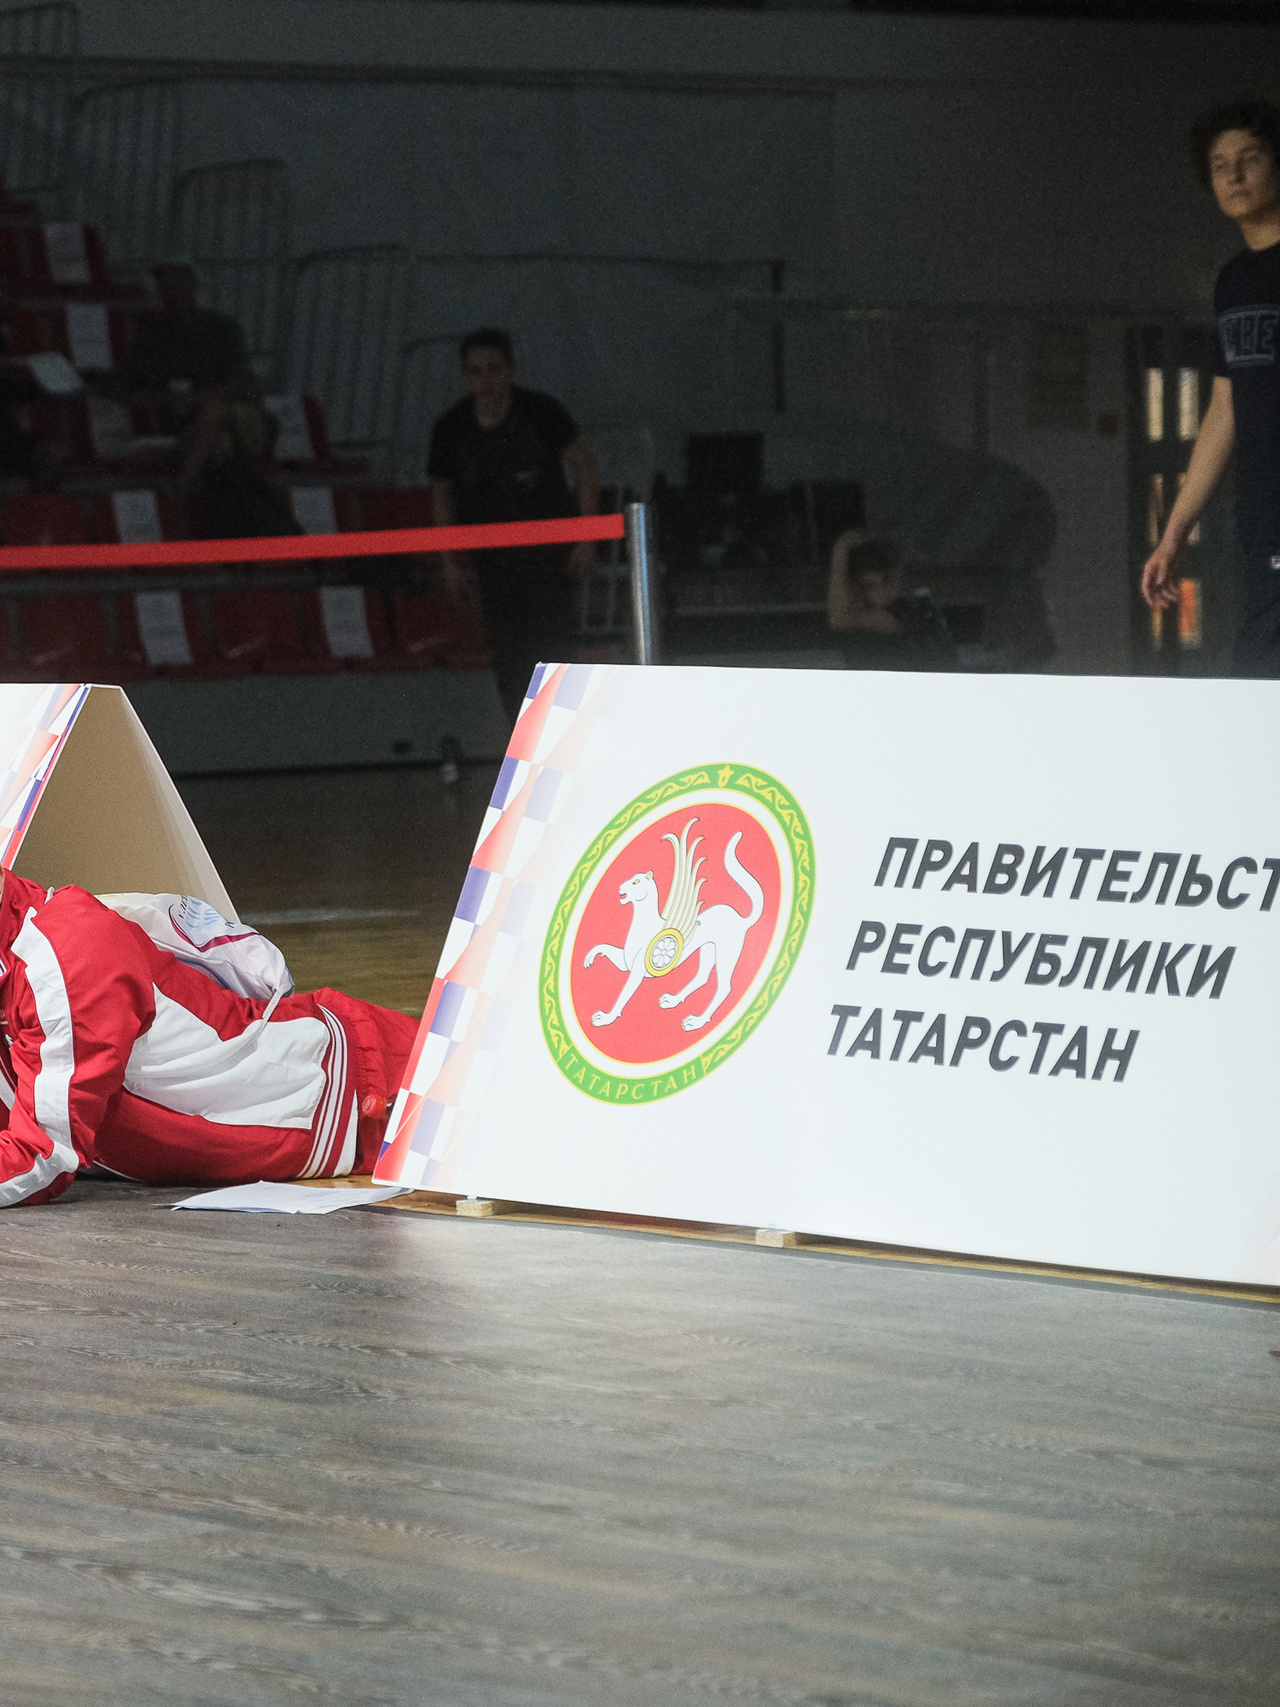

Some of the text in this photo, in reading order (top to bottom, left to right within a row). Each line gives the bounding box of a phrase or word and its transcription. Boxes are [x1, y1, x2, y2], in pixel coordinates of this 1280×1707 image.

[845, 919, 1238, 1000] РЕСПУБЛИКИ
[565, 1053, 697, 1100] ТАТАРСТАН
[826, 1003, 1141, 1084] ТАТАРСТАН
